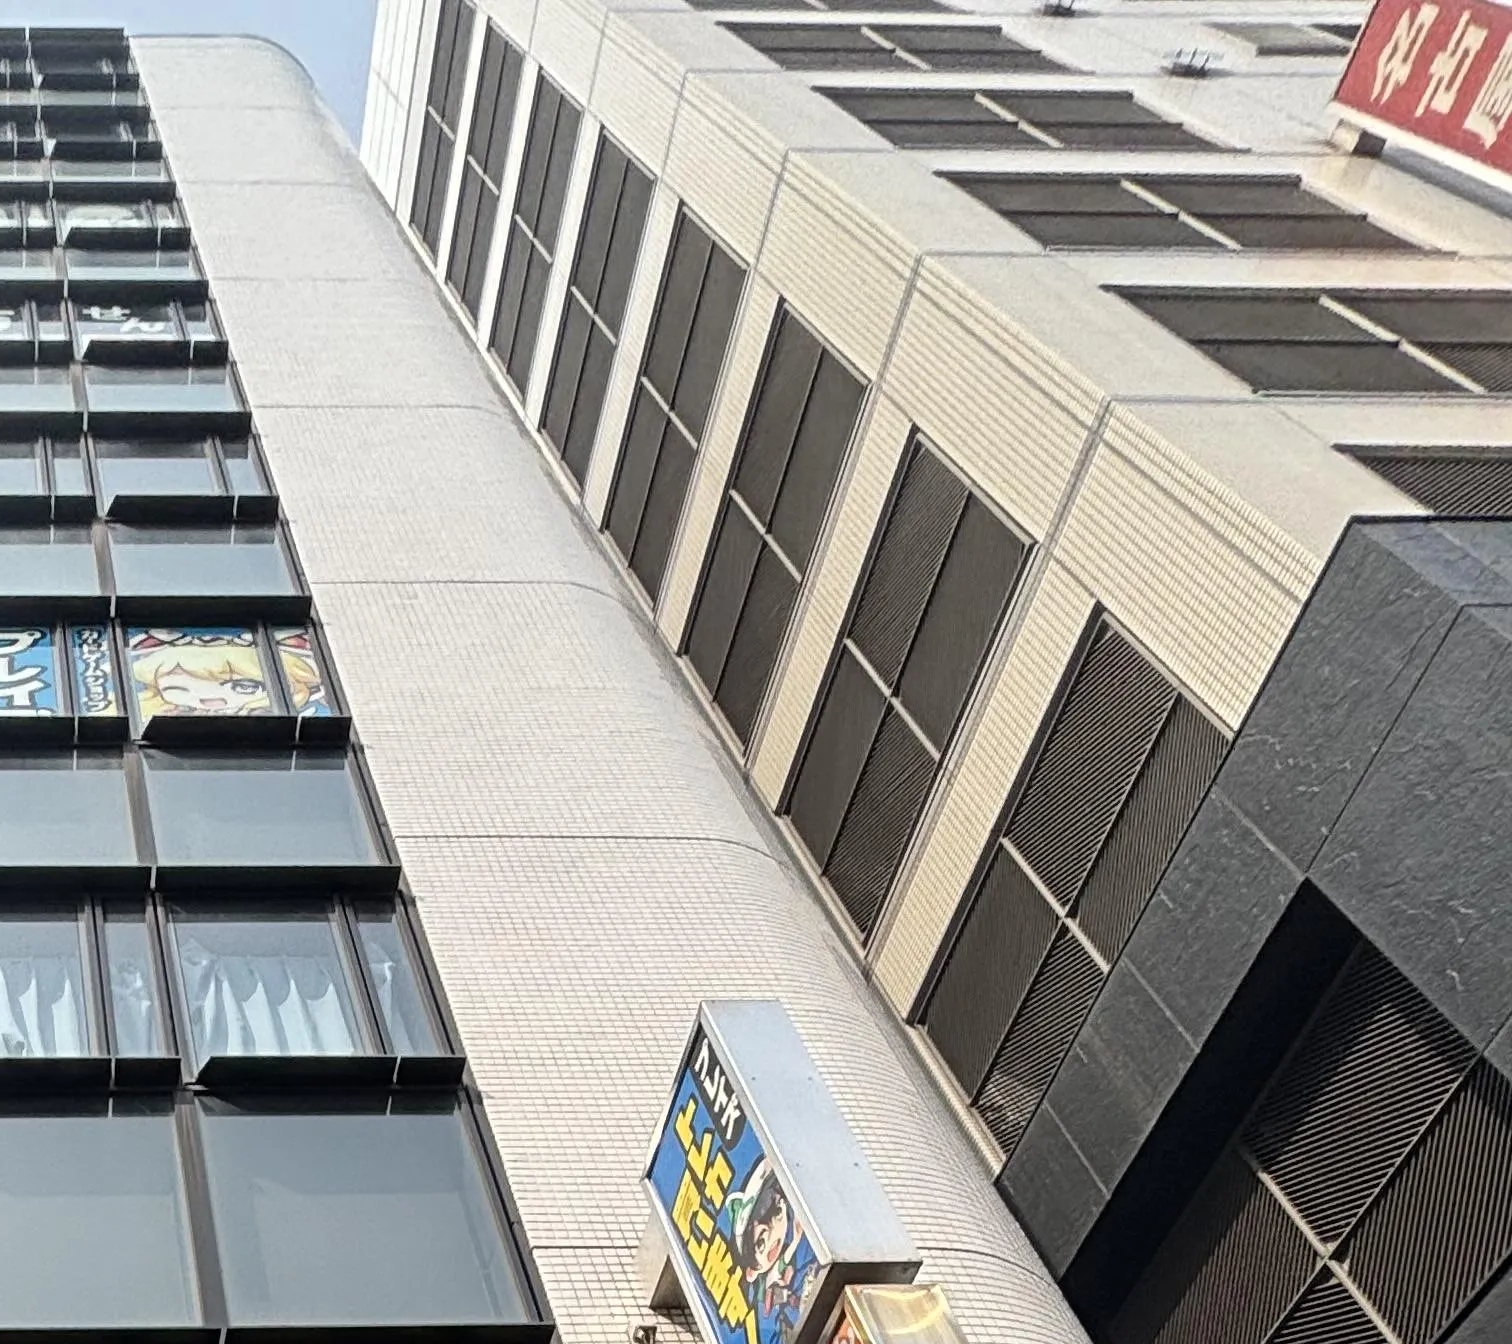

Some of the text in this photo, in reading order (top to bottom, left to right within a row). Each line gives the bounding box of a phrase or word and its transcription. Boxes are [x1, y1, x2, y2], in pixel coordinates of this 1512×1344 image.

[693, 1036, 741, 1141] プレイズ
[674, 1097, 734, 1210] トレカ
